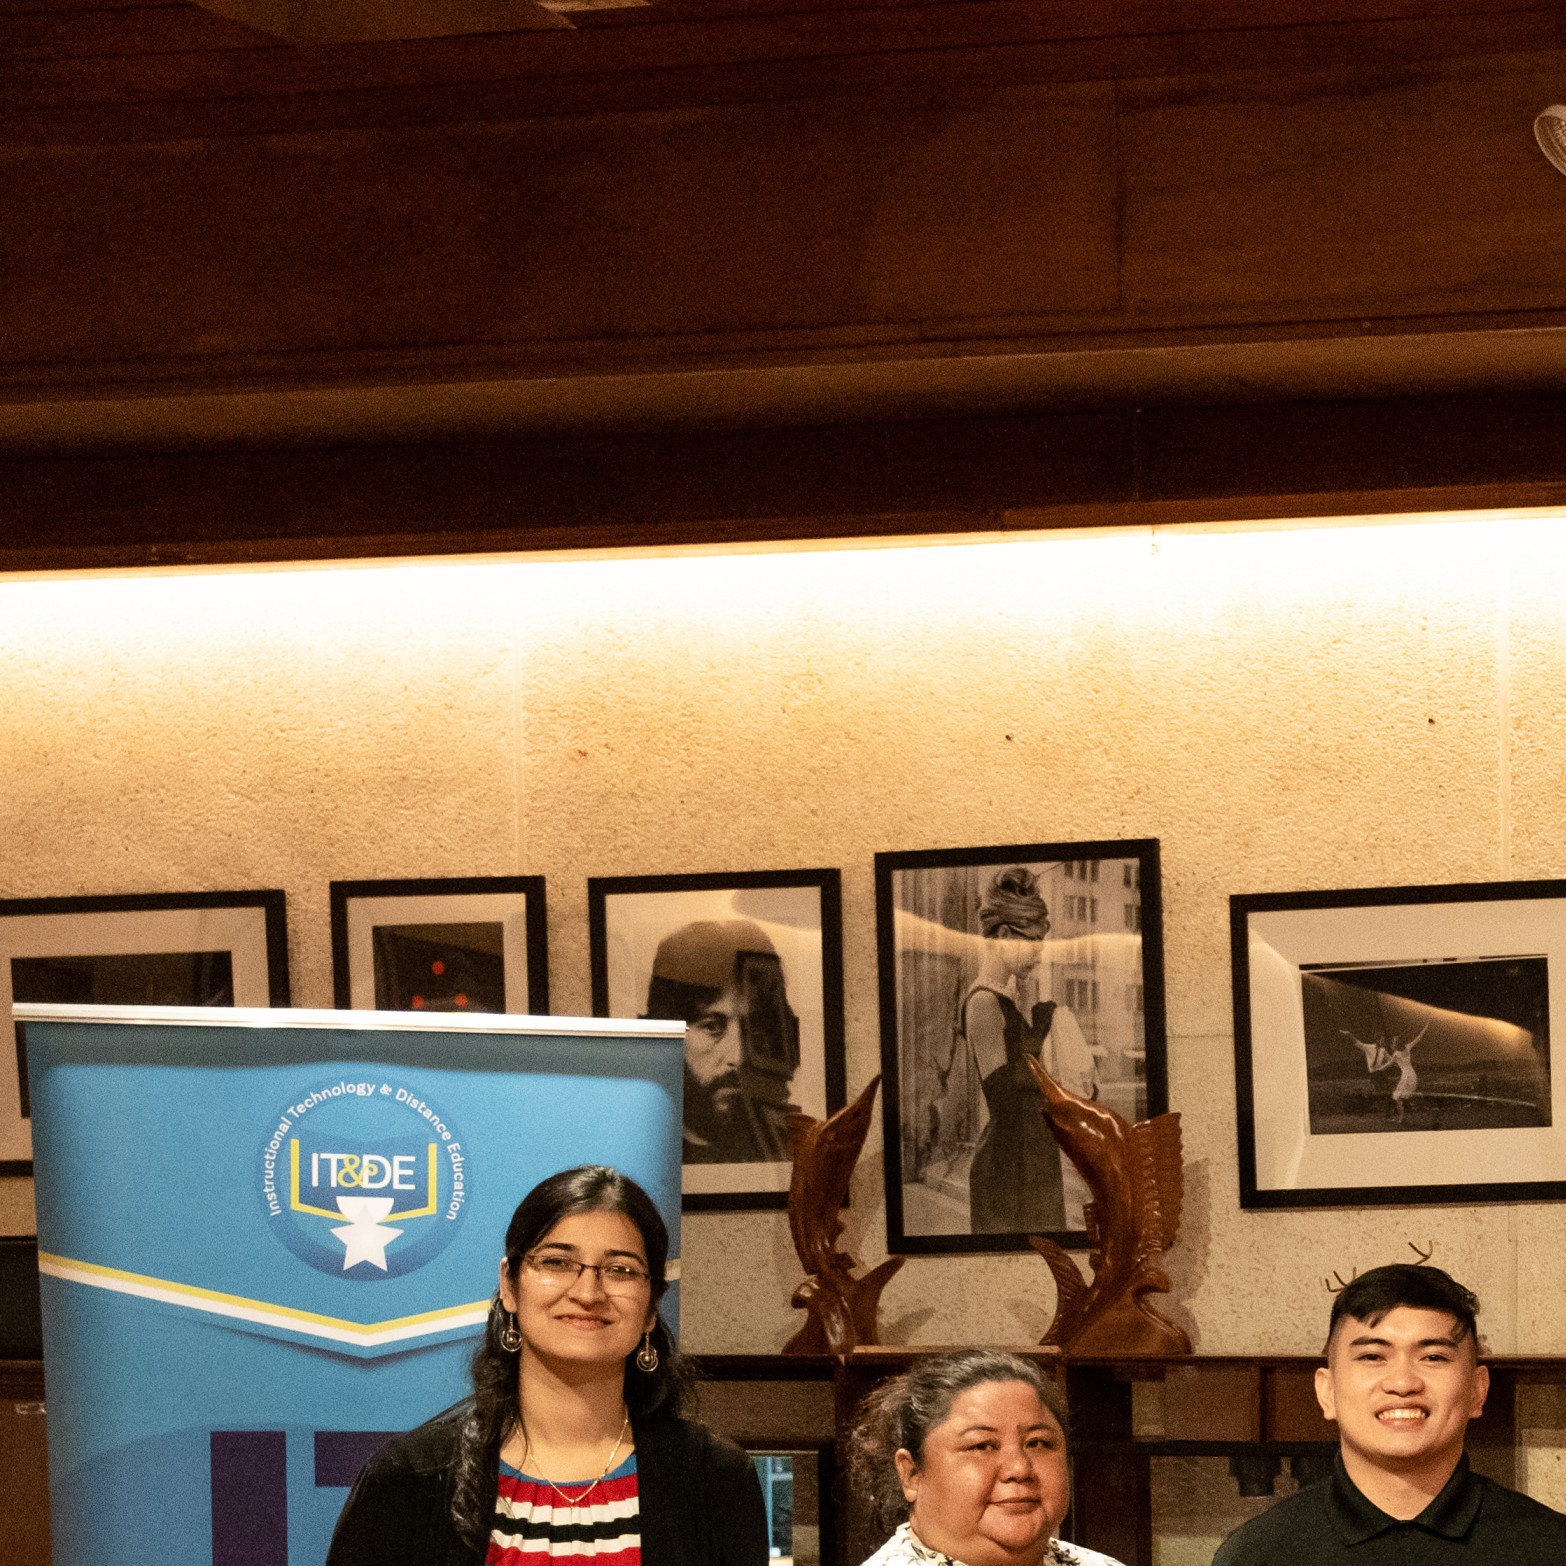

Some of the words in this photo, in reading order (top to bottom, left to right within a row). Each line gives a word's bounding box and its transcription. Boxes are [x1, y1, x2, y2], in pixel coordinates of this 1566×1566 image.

[263, 1116, 293, 1216] Instructional
[287, 1081, 376, 1119] Technology
[379, 1083, 393, 1096] &
[395, 1088, 452, 1141] Distance
[446, 1142, 466, 1221] Education
[311, 1152, 416, 1190] IT&DE
